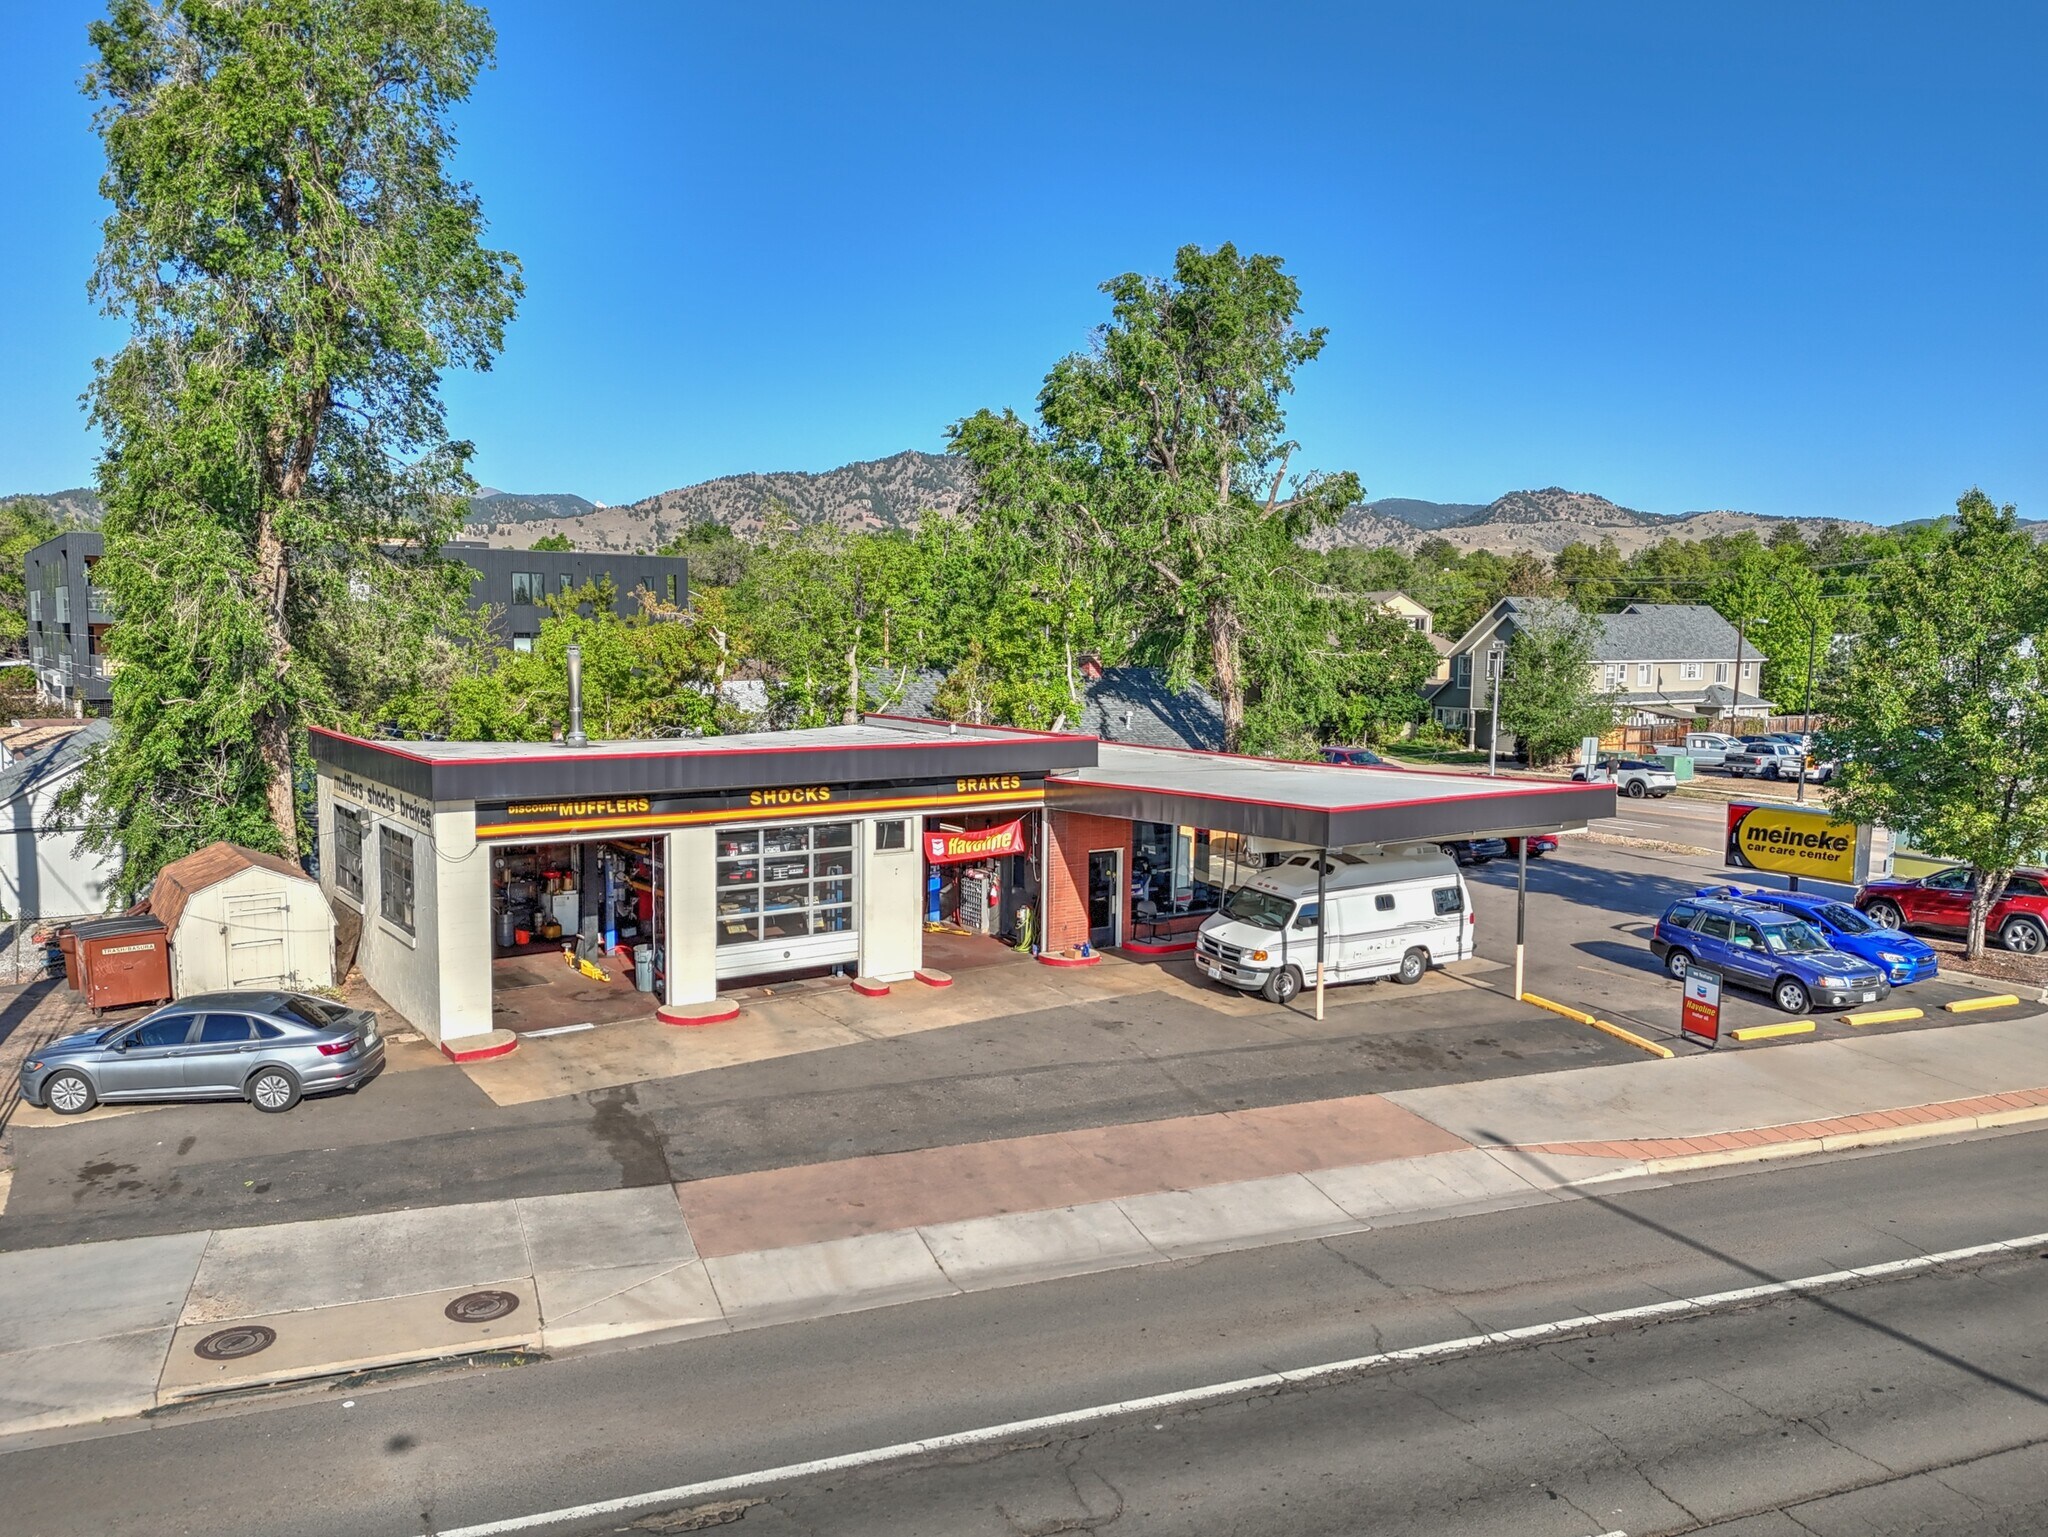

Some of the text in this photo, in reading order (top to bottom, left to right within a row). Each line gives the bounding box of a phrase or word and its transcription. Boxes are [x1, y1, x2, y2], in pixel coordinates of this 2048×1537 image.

[956, 775, 1021, 793] BRAKES
[750, 786, 831, 806] SHOCKS
[367, 783, 396, 813] shocks
[400, 793, 432, 829] brakes
[508, 798, 650, 817] DISCOUNT MUFFLERS
[947, 832, 1013, 855] Havoline
[1746, 826, 1849, 852] meineke
[1747, 843, 1841, 862] car care center
[1686, 1000, 1716, 1017] Havoline
